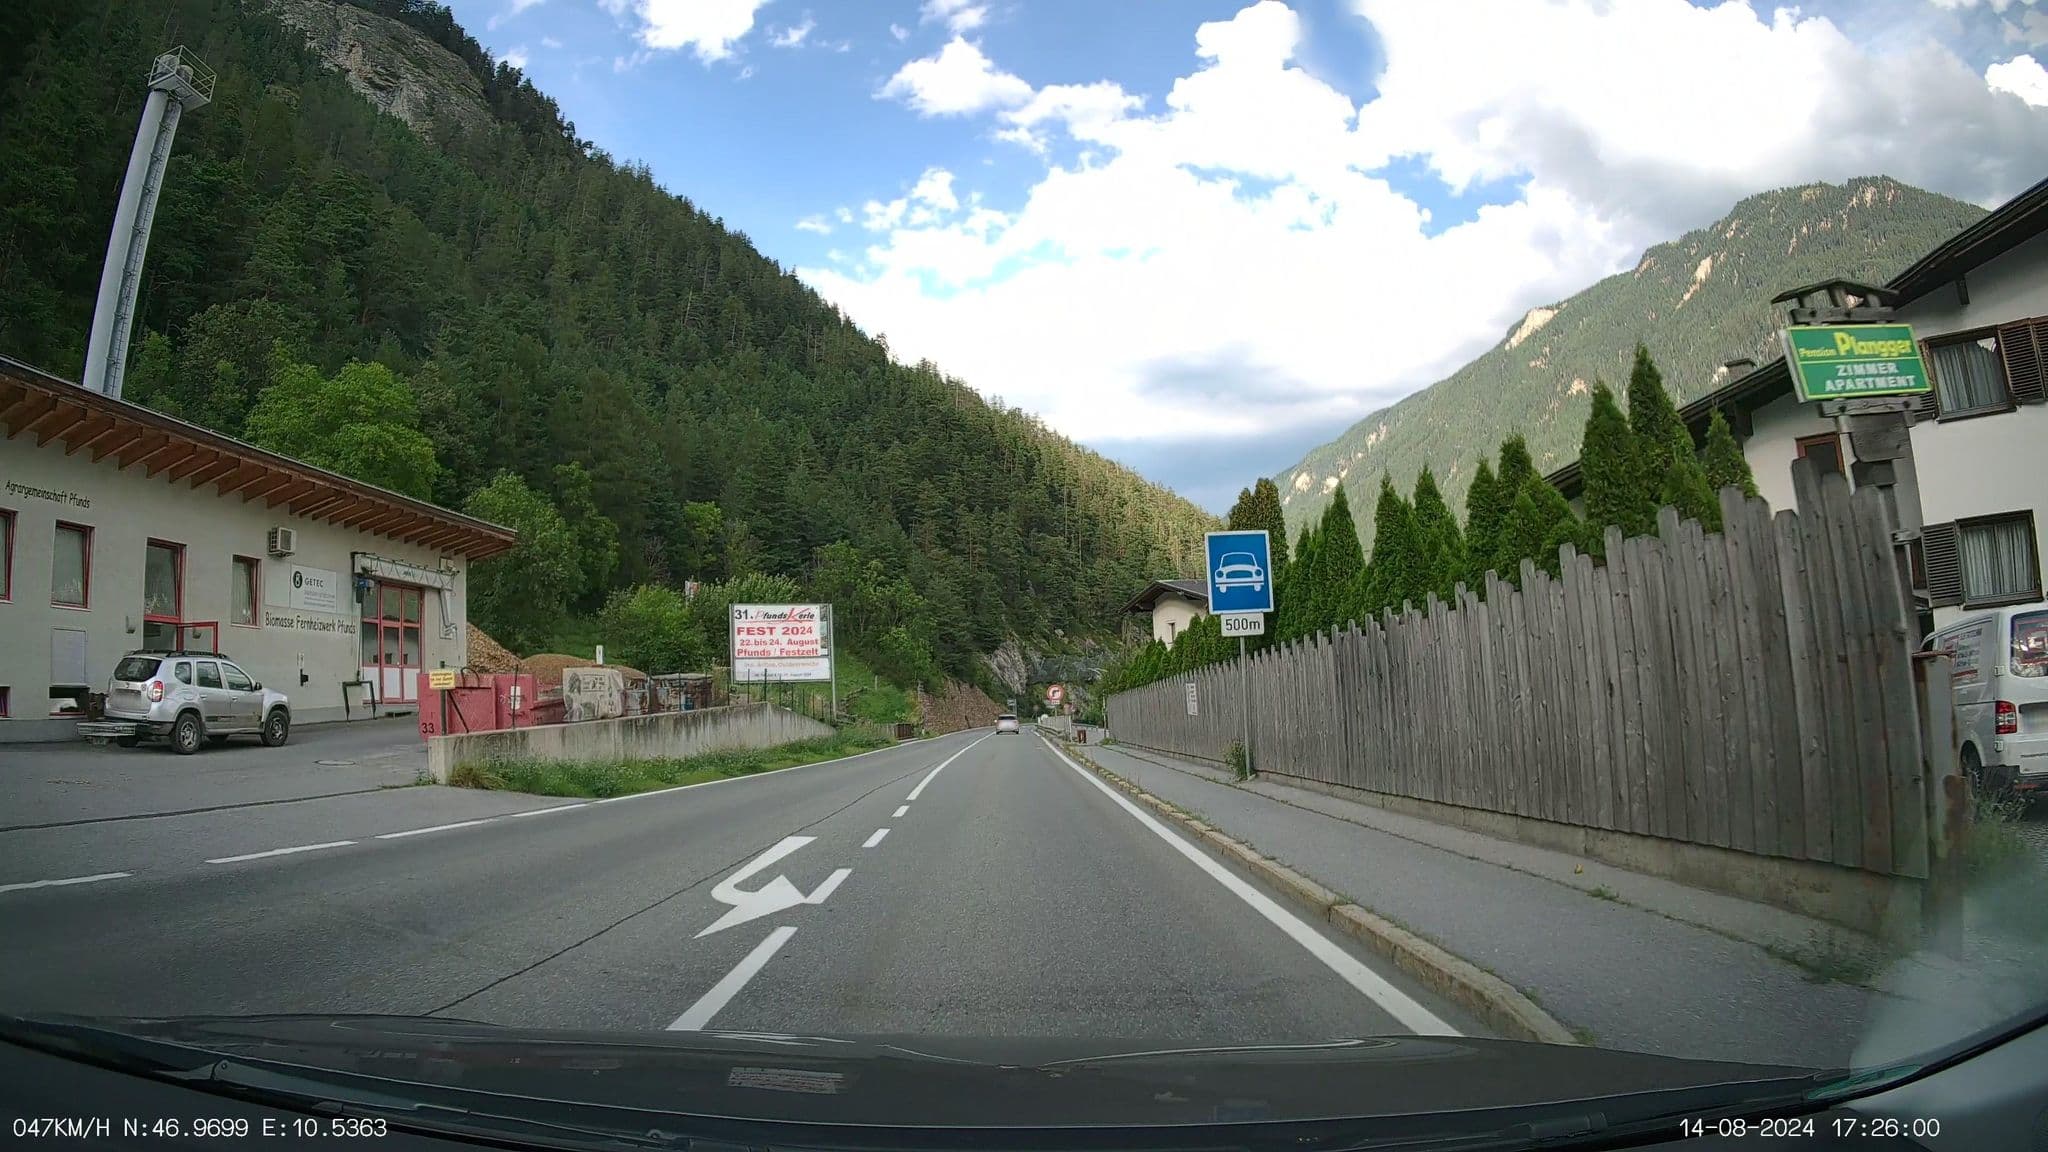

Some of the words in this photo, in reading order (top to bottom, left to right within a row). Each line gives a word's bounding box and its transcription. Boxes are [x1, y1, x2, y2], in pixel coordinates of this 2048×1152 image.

[1834, 331, 1912, 357] Plangger
[1836, 362, 1899, 376] ZIMMER
[1824, 375, 1916, 392] APARTMENT
[5, 479, 67, 504] Agrargemeinschaft
[68, 492, 91, 509] Pfunds
[304, 577, 324, 588] GETEC
[735, 609, 754, 620] 31.
[265, 611, 294, 628] Biomasse
[296, 615, 336, 633] Fernheizwerk
[337, 619, 356, 635] Pfunds
[1225, 618, 1260, 631] 500m
[736, 626, 776, 636] FEST
[782, 626, 813, 636] 2024
[754, 638, 768, 647] bis
[769, 638, 782, 647] 24.
[787, 638, 818, 648] August
[737, 648, 771, 657] Pfunds
[779, 648, 818, 657] Festzelt
[421, 722, 435, 734] 33
